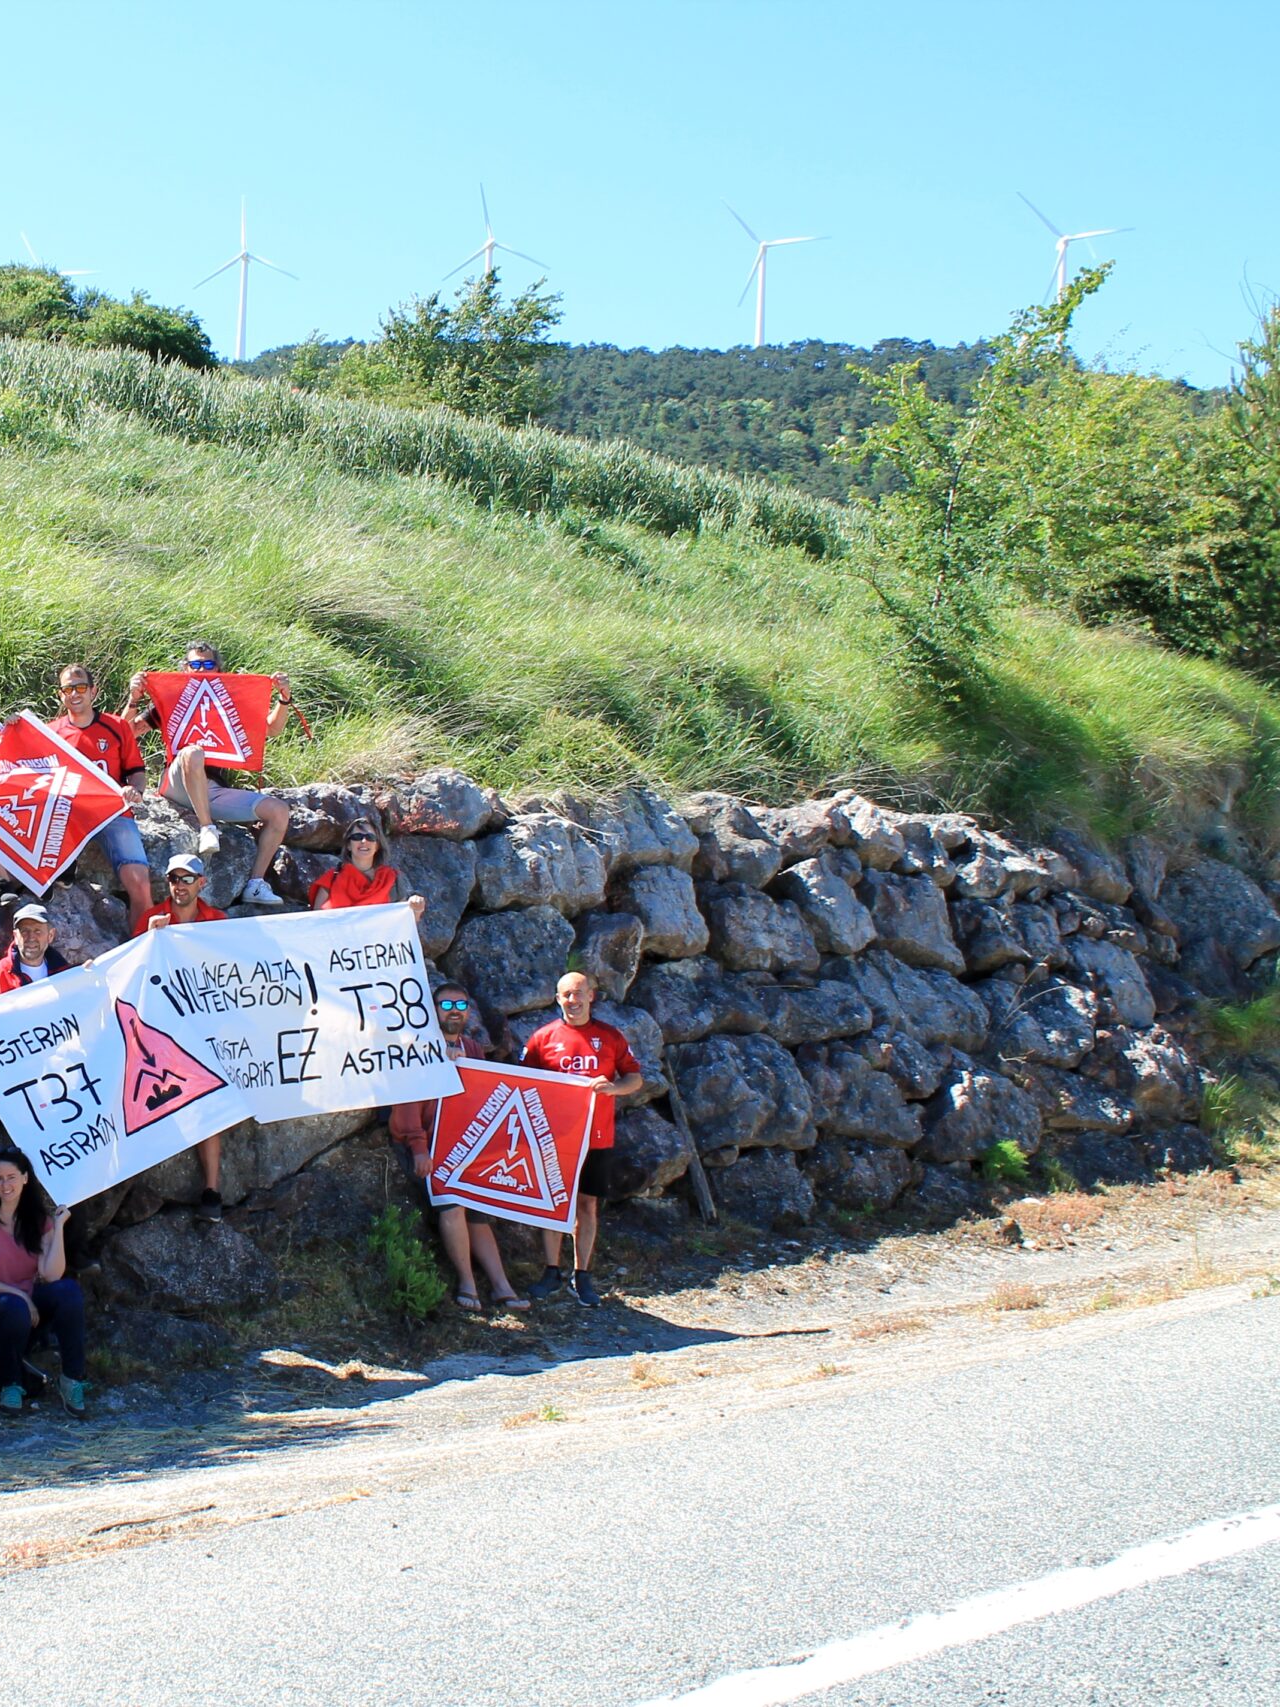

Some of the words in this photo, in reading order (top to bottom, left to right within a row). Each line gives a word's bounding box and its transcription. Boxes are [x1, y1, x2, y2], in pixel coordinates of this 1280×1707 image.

[40, 857, 58, 868] EZ
[250, 958, 301, 983] ALTA
[278, 1027, 322, 1084] EZ
[560, 1055, 598, 1070] can
[434, 1165, 450, 1182] NO
[443, 1142, 470, 1169] LINEA
[462, 1121, 485, 1147] ALTA
[476, 1082, 512, 1124] TENSION
[523, 1087, 550, 1137] AUTOPISTA
[538, 1133, 565, 1195] ELEKTRIKORIK
[554, 1192, 568, 1206] EZ
